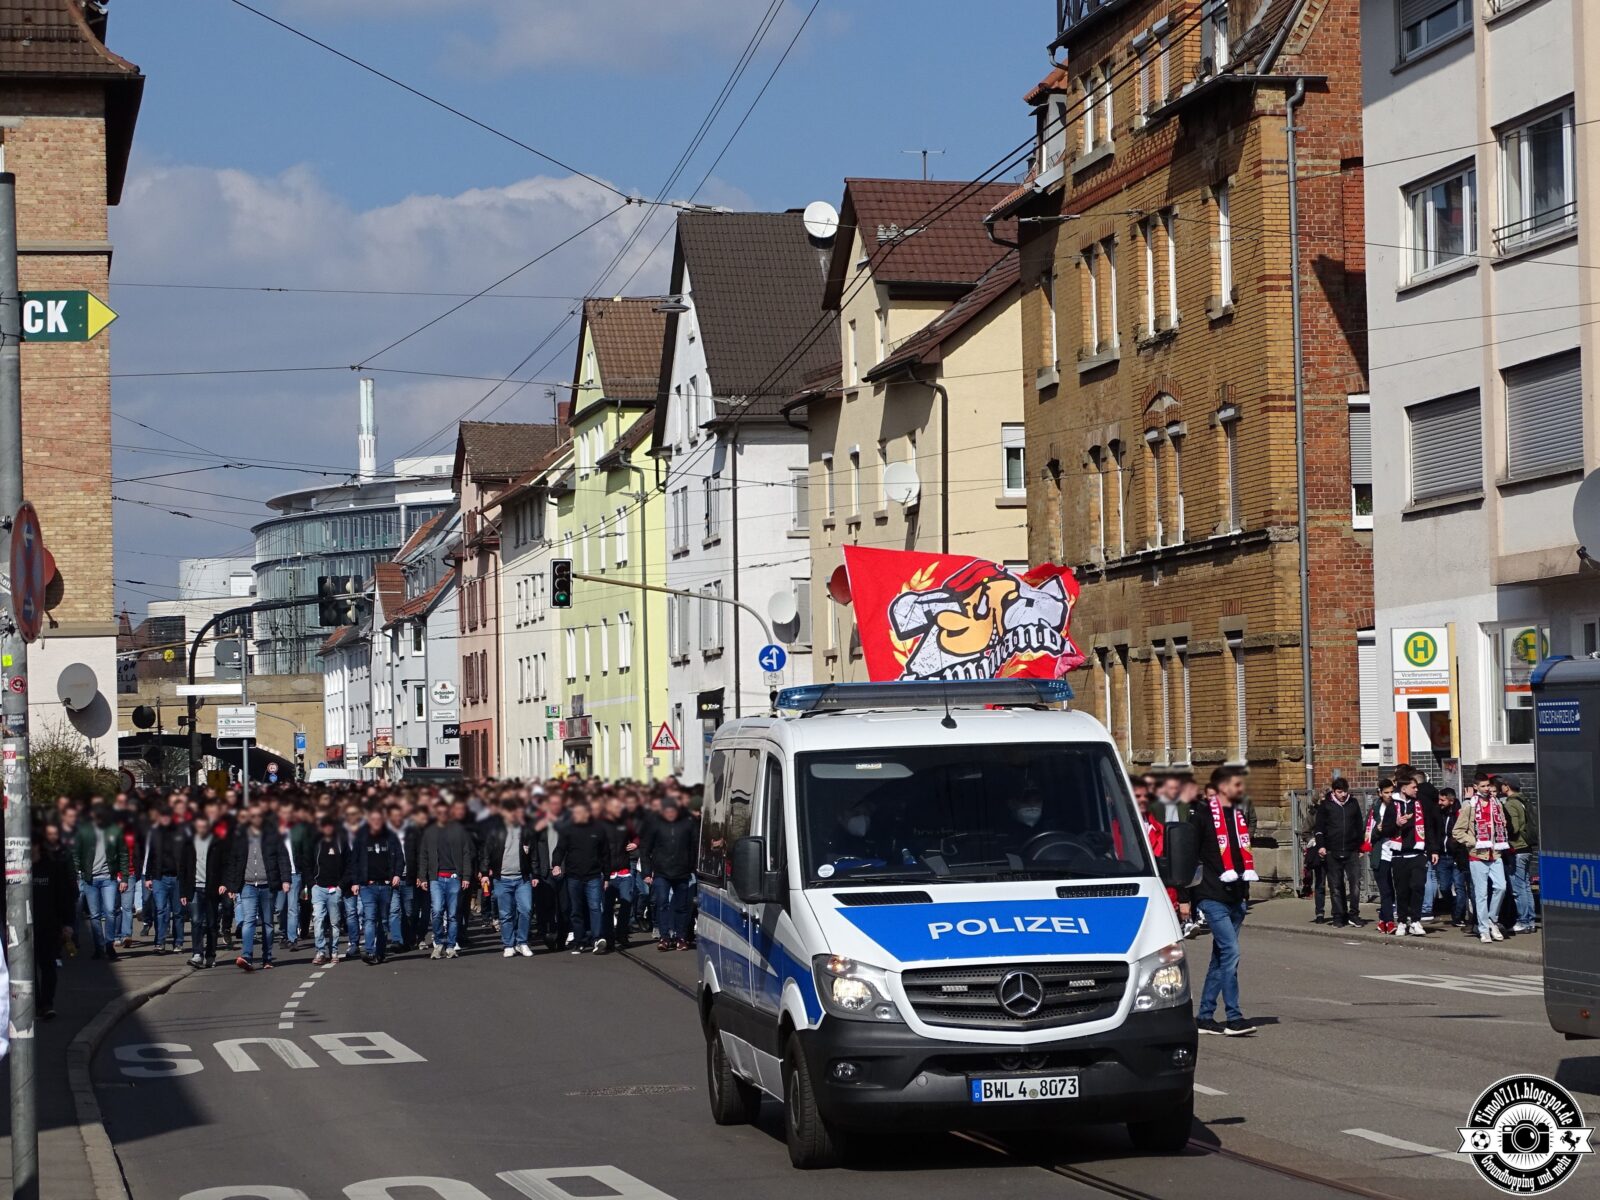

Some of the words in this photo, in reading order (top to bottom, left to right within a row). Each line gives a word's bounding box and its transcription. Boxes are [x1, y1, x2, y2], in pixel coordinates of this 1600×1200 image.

[23, 300, 68, 333] CK
[1413, 640, 1429, 658] H
[434, 736, 450, 745] 103
[444, 727, 458, 736] sky
[1570, 864, 1600, 898] POL
[928, 916, 1090, 940] POLIZEI
[113, 1031, 428, 1078] BUS
[984, 1082, 1014, 1099] BWL
[1018, 1081, 1028, 1097] 4
[1040, 1078, 1077, 1096] 8073
